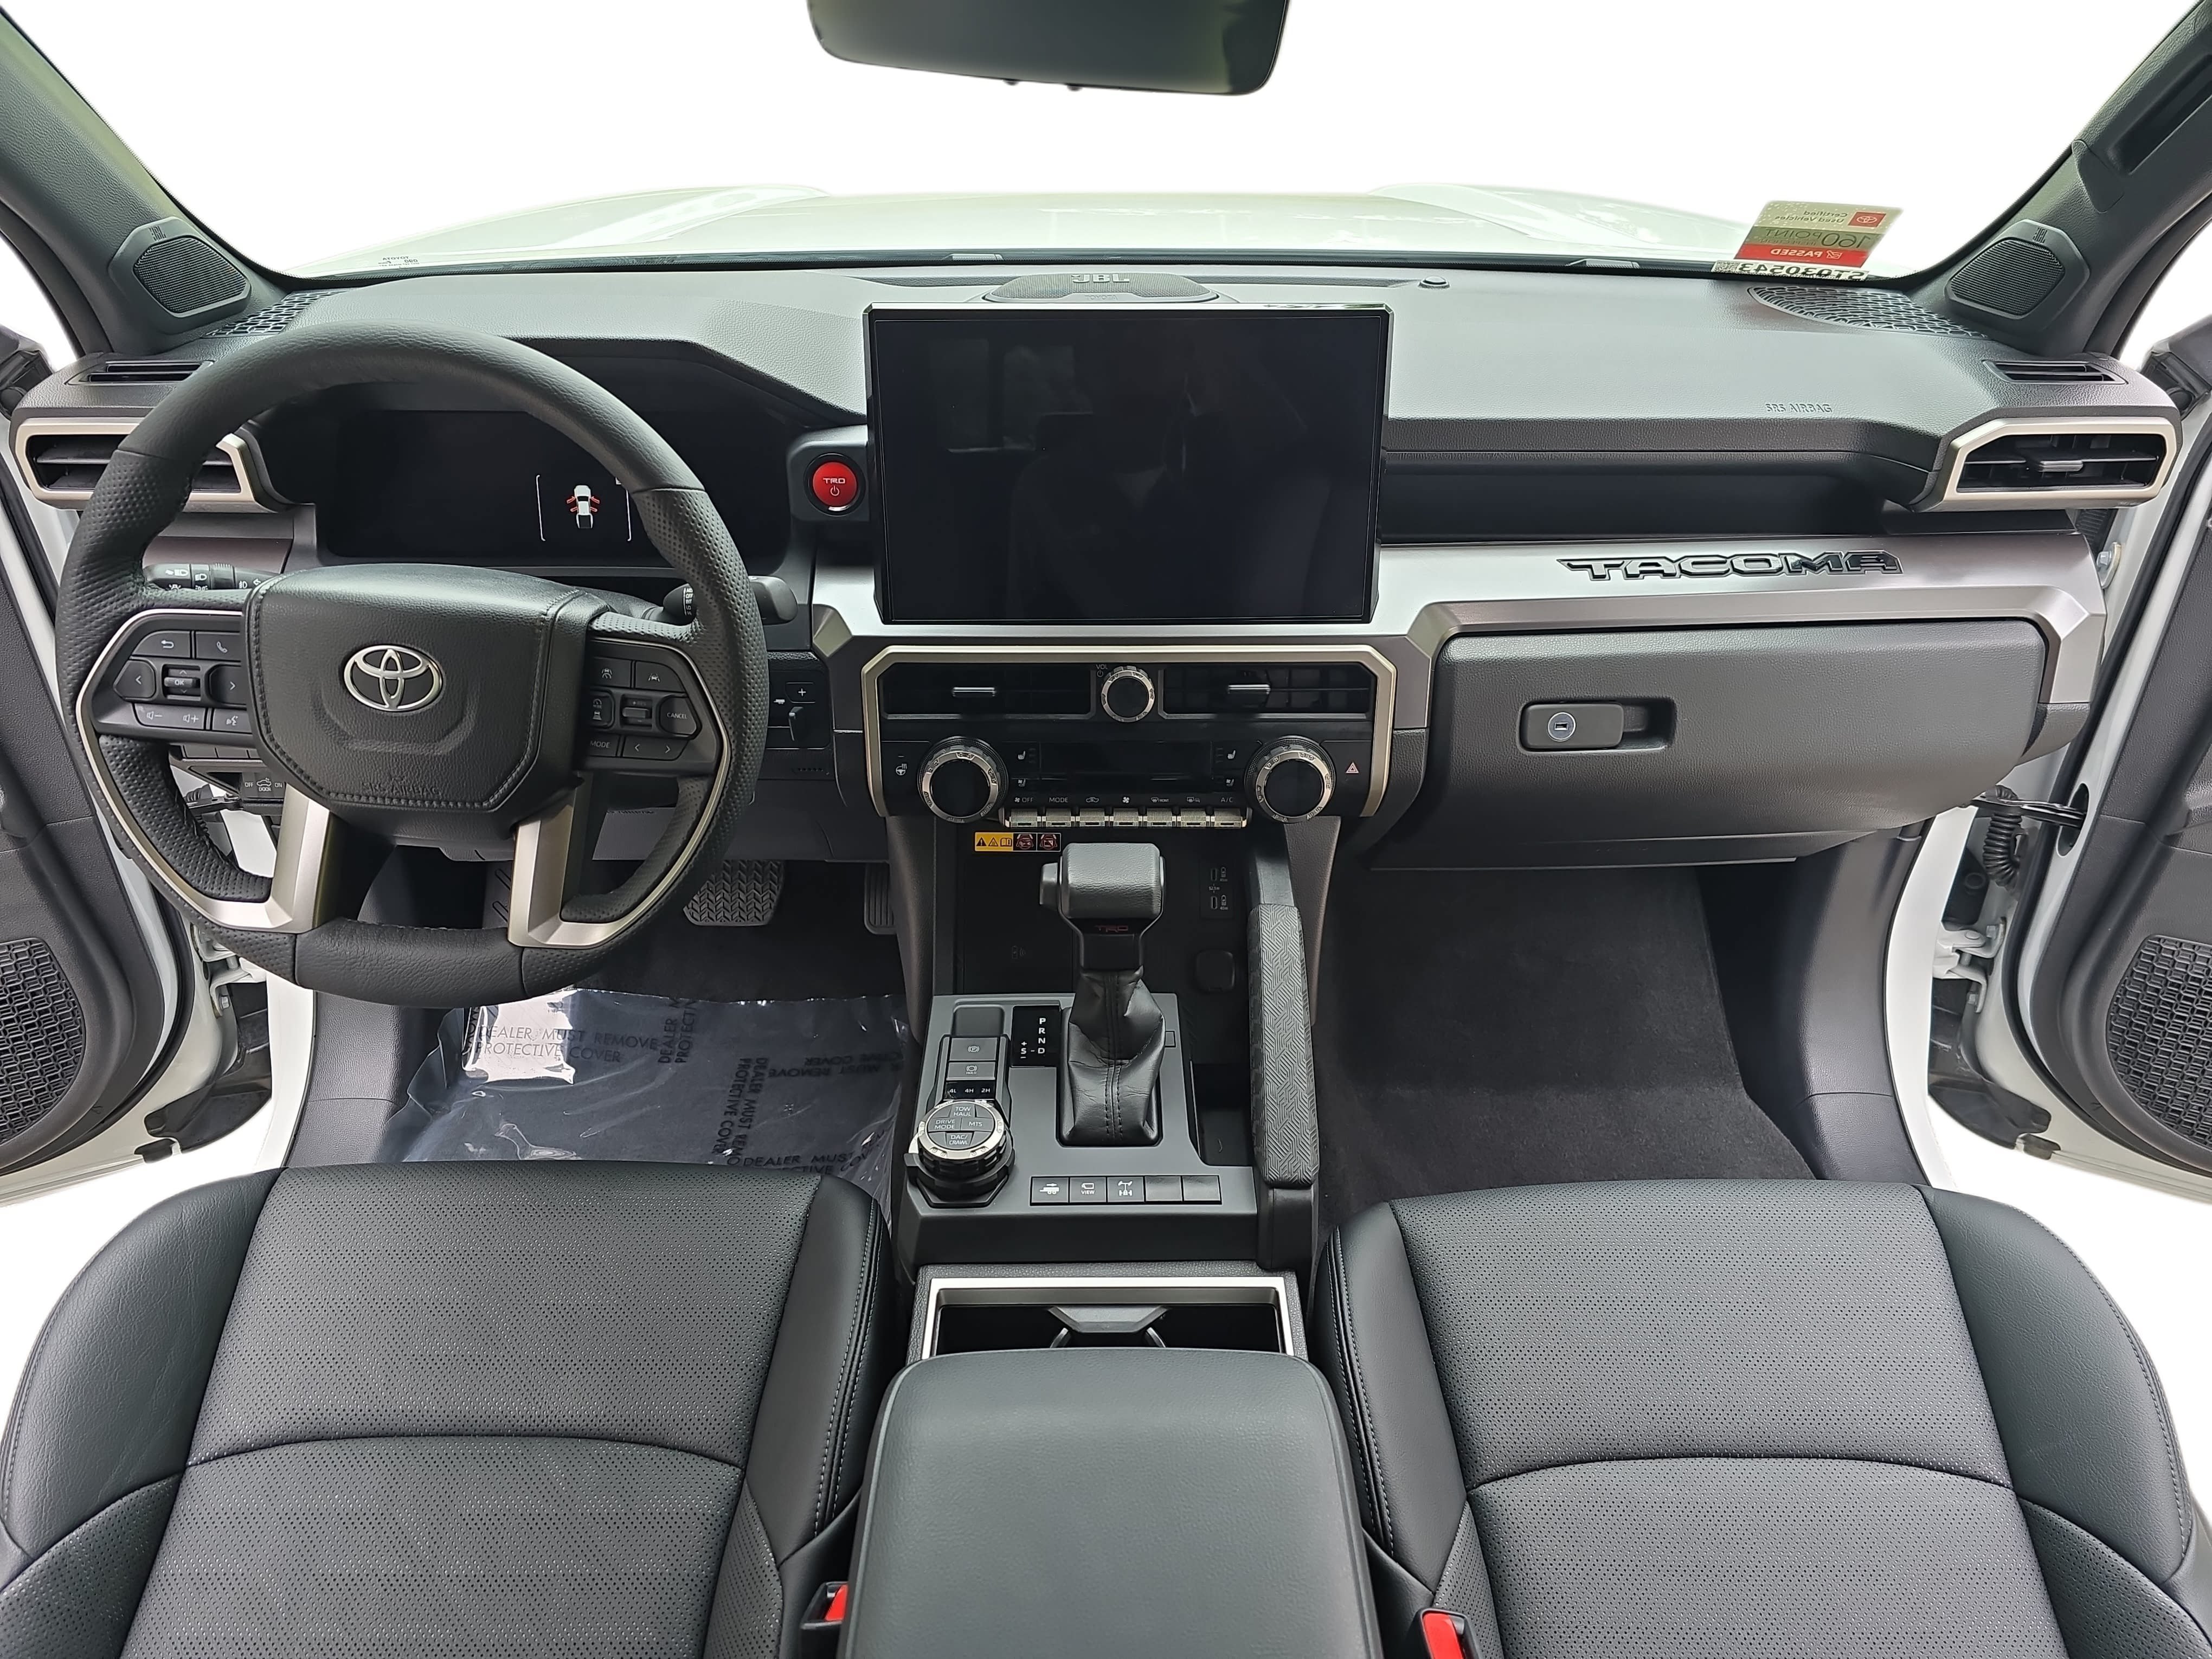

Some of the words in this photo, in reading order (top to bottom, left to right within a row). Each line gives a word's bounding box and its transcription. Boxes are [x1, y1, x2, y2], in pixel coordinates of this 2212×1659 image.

[1071, 273, 1130, 283] JBL
[1765, 403, 1786, 413] SRS
[1789, 403, 1832, 413] AIRBAG
[1555, 549, 1904, 581] TACOMA
[589, 740, 610, 748] MODE
[478, 1024, 532, 1041] DEALER
[543, 1028, 589, 1043] MUST
[594, 1031, 659, 1050] REMOVE
[657, 1018, 678, 1064] DEALER
[674, 1000, 698, 1064] PROTECTI
[476, 1041, 562, 1058] PROTECTIVE
[569, 1045, 621, 1063] COVER
[723, 1058, 751, 1117] PROTECTIVE
[750, 1057, 769, 1094] DEALER
[737, 1098, 757, 1130] MUST
[743, 1155, 802, 1167] DEALER
